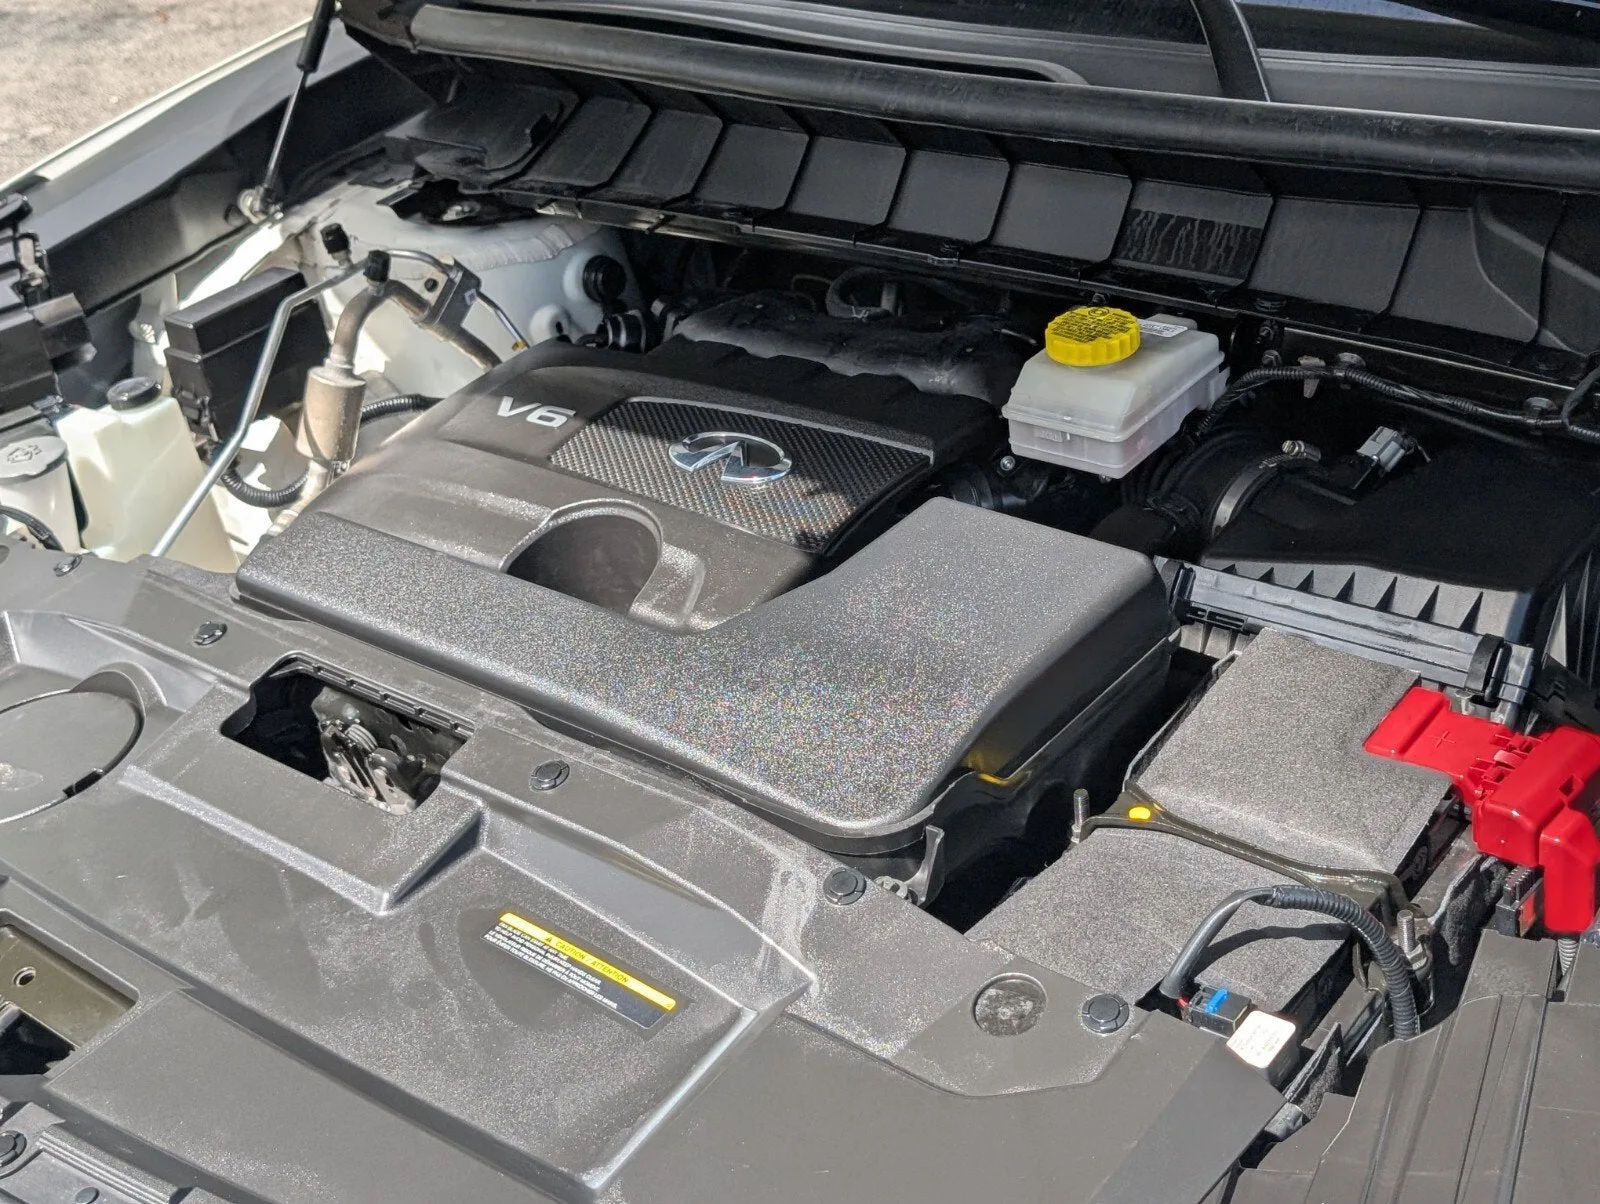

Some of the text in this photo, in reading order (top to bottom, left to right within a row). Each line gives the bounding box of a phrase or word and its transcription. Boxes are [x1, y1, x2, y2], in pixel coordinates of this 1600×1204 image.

[497, 396, 577, 428] V6
[554, 941, 586, 959] CAUTION
[589, 960, 629, 983] ATTENTION
